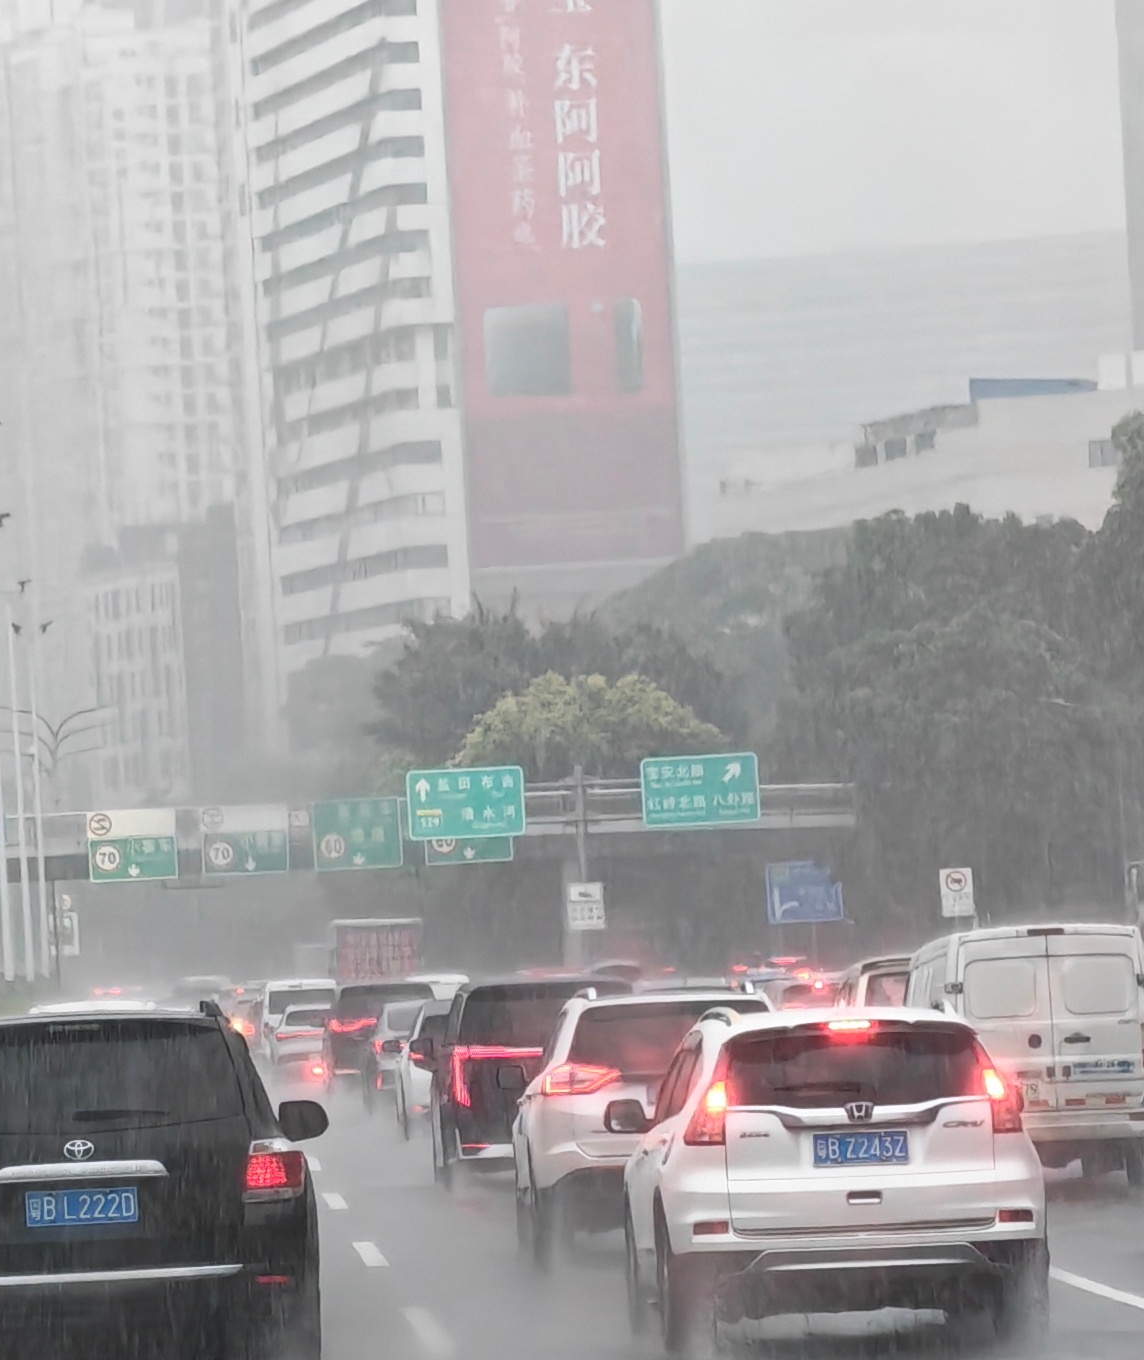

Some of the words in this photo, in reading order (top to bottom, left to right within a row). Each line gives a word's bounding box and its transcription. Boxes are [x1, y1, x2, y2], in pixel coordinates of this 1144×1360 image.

[554, 43, 606, 249] 东阿阿胶
[99, 852, 116, 864] 70
[213, 846, 230, 860] 70
